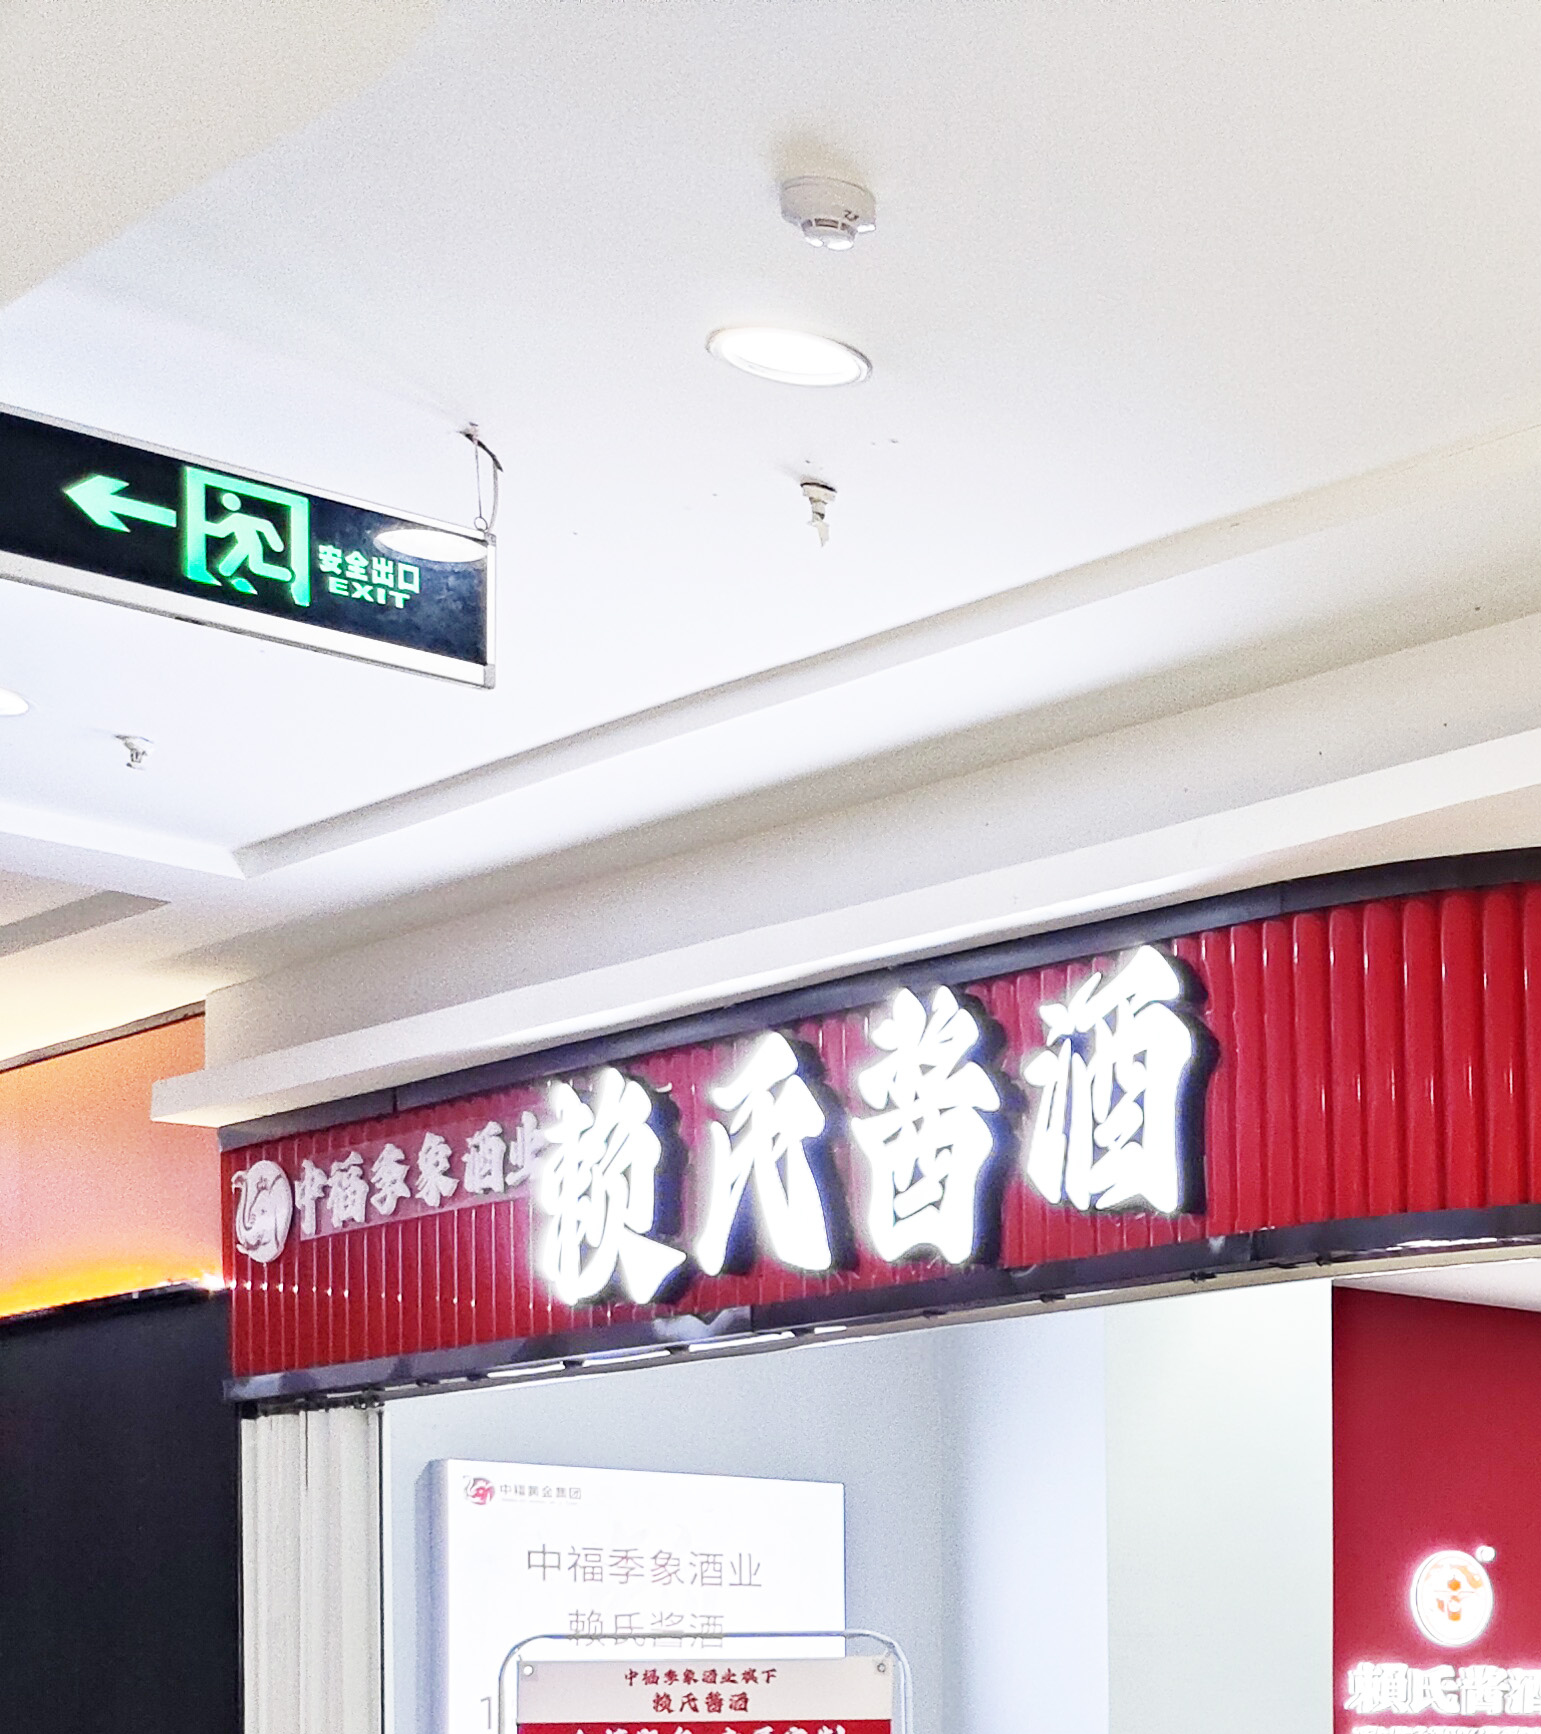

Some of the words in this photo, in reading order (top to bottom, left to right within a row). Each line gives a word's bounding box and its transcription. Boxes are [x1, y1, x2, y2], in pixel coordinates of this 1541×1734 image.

[318, 544, 420, 595] 安全出口
[329, 576, 411, 609] EXIT
[540, 943, 1196, 1306] 赖氏酱酒
[294, 1110, 548, 1235] 中福季象酒业
[526, 1544, 762, 1588] 中福季象酒业
[567, 1609, 725, 1649] 赖氏酱酒
[624, 1668, 778, 1686] 中福季象酒业旗下
[652, 1692, 750, 1713] 赖氏酱酒
